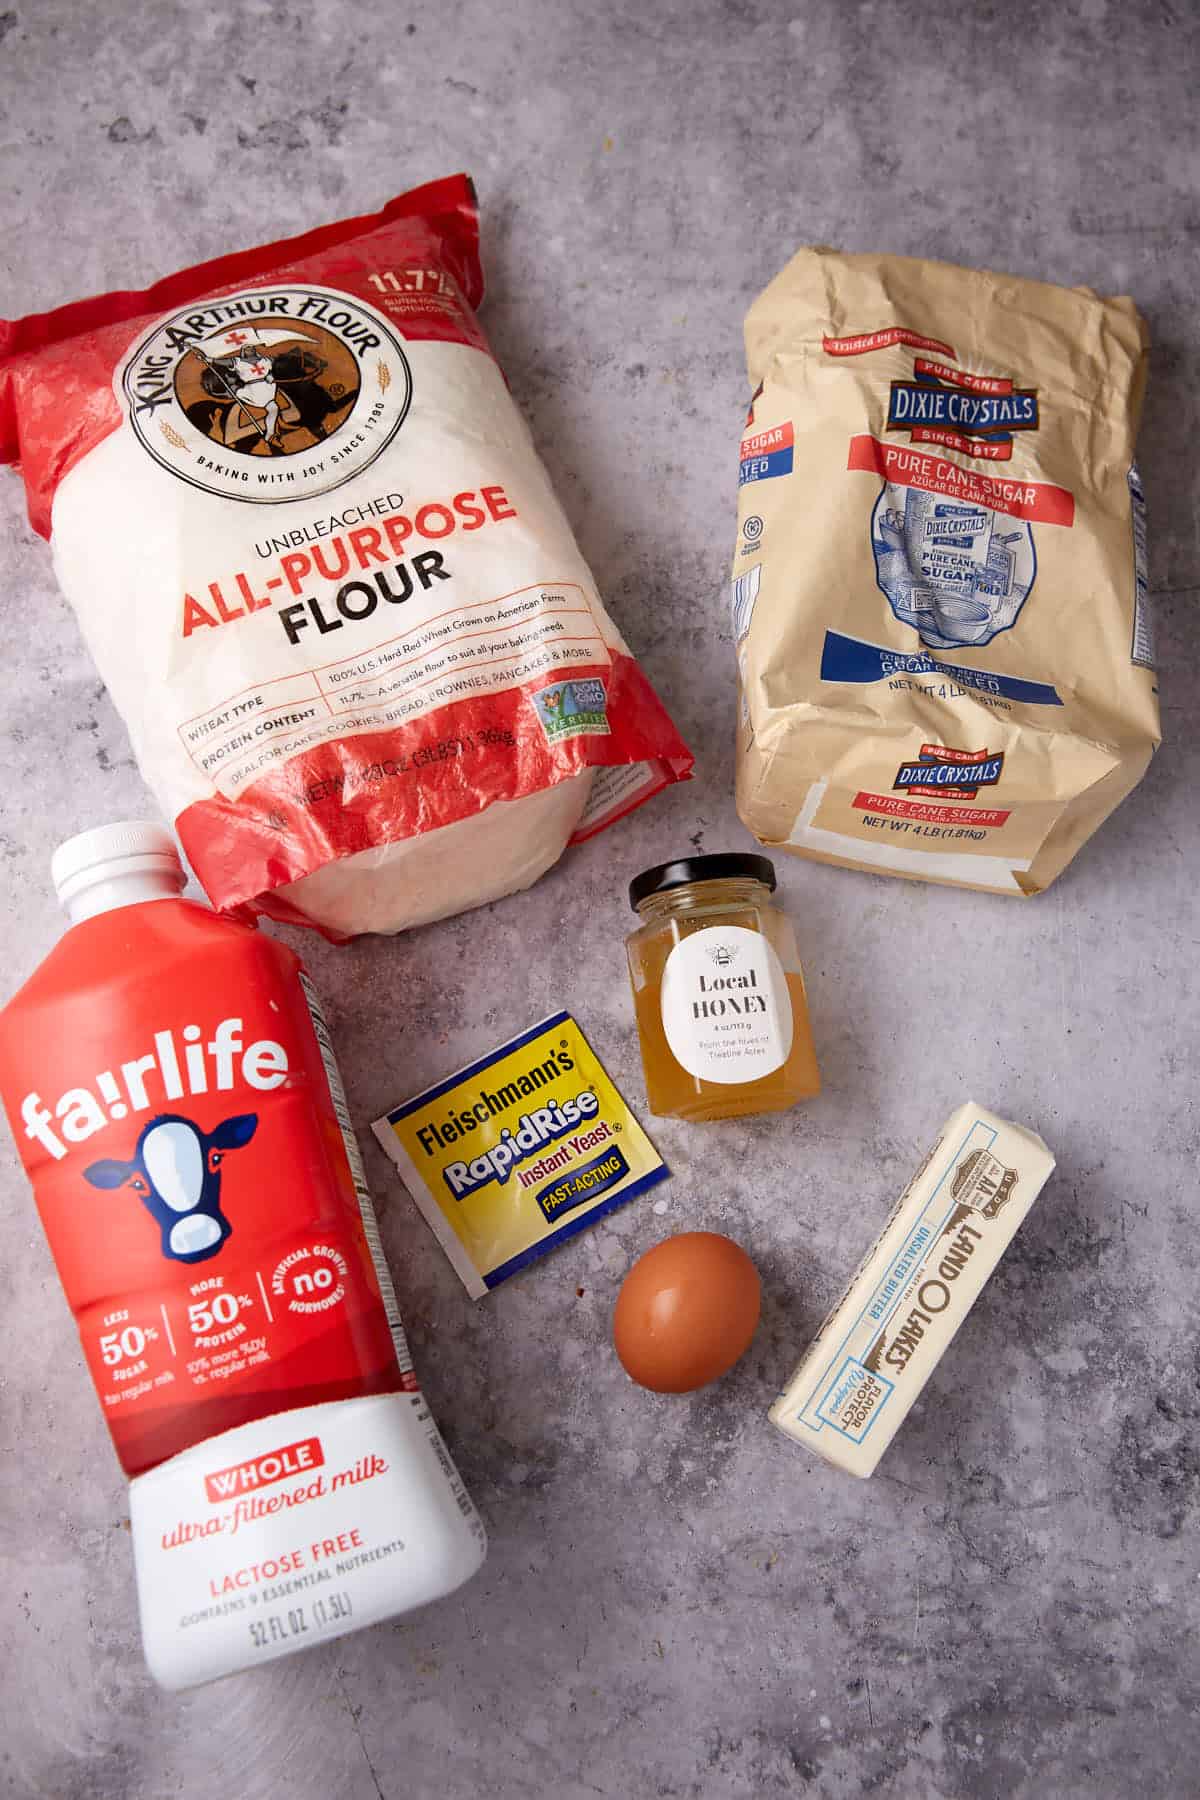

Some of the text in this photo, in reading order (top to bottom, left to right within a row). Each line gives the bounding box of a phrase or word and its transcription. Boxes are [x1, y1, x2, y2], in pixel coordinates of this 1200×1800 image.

[135, 296, 380, 416] KING ARTHUR FLOUR
[832, 335, 874, 351] Trusted
[925, 362, 1001, 392] PURE CANE
[895, 389, 1033, 423] DIXIE CRYSTALS
[196, 401, 385, 484] BAKING WITH JOY SINCE 1790
[743, 430, 783, 451] SUGAR
[922, 430, 999, 457] SINCE 1917
[886, 450, 1037, 506] PURE CANE SUGAR
[910, 472, 946, 491] AZÚCAR
[948, 484, 960, 497] DE
[962, 487, 986, 505] CAÑA
[255, 492, 405, 559] UNBLEACHED
[926, 518, 985, 535] DIXIE CRYSTALS
[182, 486, 517, 637] ALL-PURPOSE
[921, 566, 975, 582] SUGAR
[922, 552, 949, 564] PURE
[951, 556, 977, 569] CANE
[278, 550, 452, 644] FLOUR
[329, 669, 357, 683] 100%
[378, 648, 402, 665] Hard
[402, 640, 421, 653] Red
[421, 625, 452, 644] Wheat
[452, 617, 483, 630] Grown
[484, 614, 496, 624] on
[497, 599, 539, 621] American
[425, 660, 446, 672] flour
[447, 654, 458, 662] to
[459, 646, 476, 658] suit
[477, 643, 488, 655] all
[488, 642, 508, 656] your
[258, 747, 282, 766] FOR
[562, 648, 592, 658] MORE
[889, 680, 913, 690] NET
[939, 685, 946, 699] 4
[188, 696, 264, 741] WHEAT TYPE
[202, 709, 316, 769] PROTEIN CONTENT
[900, 761, 999, 783] DIXIE CRYSTALS
[867, 797, 998, 821] PURE CANE SUGAR
[863, 815, 987, 841] NET WT 4 LB (1.81kg)
[699, 969, 757, 993] Local
[692, 995, 767, 1019] HONEY
[415, 1049, 575, 1156] Fleischmann's
[444, 1090, 599, 1200] RapidRise
[517, 1121, 613, 1188] Instant Yeast
[541, 1156, 621, 1213] FAST-ACTING
[976, 1175, 998, 1196] AA
[313, 1245, 348, 1275] GROWTH
[939, 1224, 983, 1281] LAND
[190, 1277, 224, 1296] MORE
[294, 1268, 332, 1296] no
[868, 1226, 930, 1320] UNSALTED BUTTER
[188, 1293, 253, 1333] 50%
[918, 1279, 951, 1314] O
[104, 1309, 129, 1327] LESS
[195, 1323, 247, 1348] PROTEIN
[100, 1327, 159, 1366] 50%
[885, 1308, 932, 1371] LAKES
[113, 1360, 148, 1381] SUGAR
[210, 1359, 246, 1379] regular
[248, 1350, 272, 1366] milk
[121, 1380, 153, 1400] regular
[842, 1375, 875, 1427] PROTECT
[851, 1385, 882, 1429] FLAVOR
[209, 1443, 313, 1496] WHOLE
[161, 1454, 390, 1550] ultra-filtered milk
[209, 1529, 364, 1598] LACTOSE FREE
[180, 1598, 247, 1629] CONTAINS
[262, 1568, 332, 1601] ESSENTIAL
[335, 1540, 405, 1574] NUTRIENTS
[250, 1591, 352, 1648] 52 FL OZ (1.5L)
